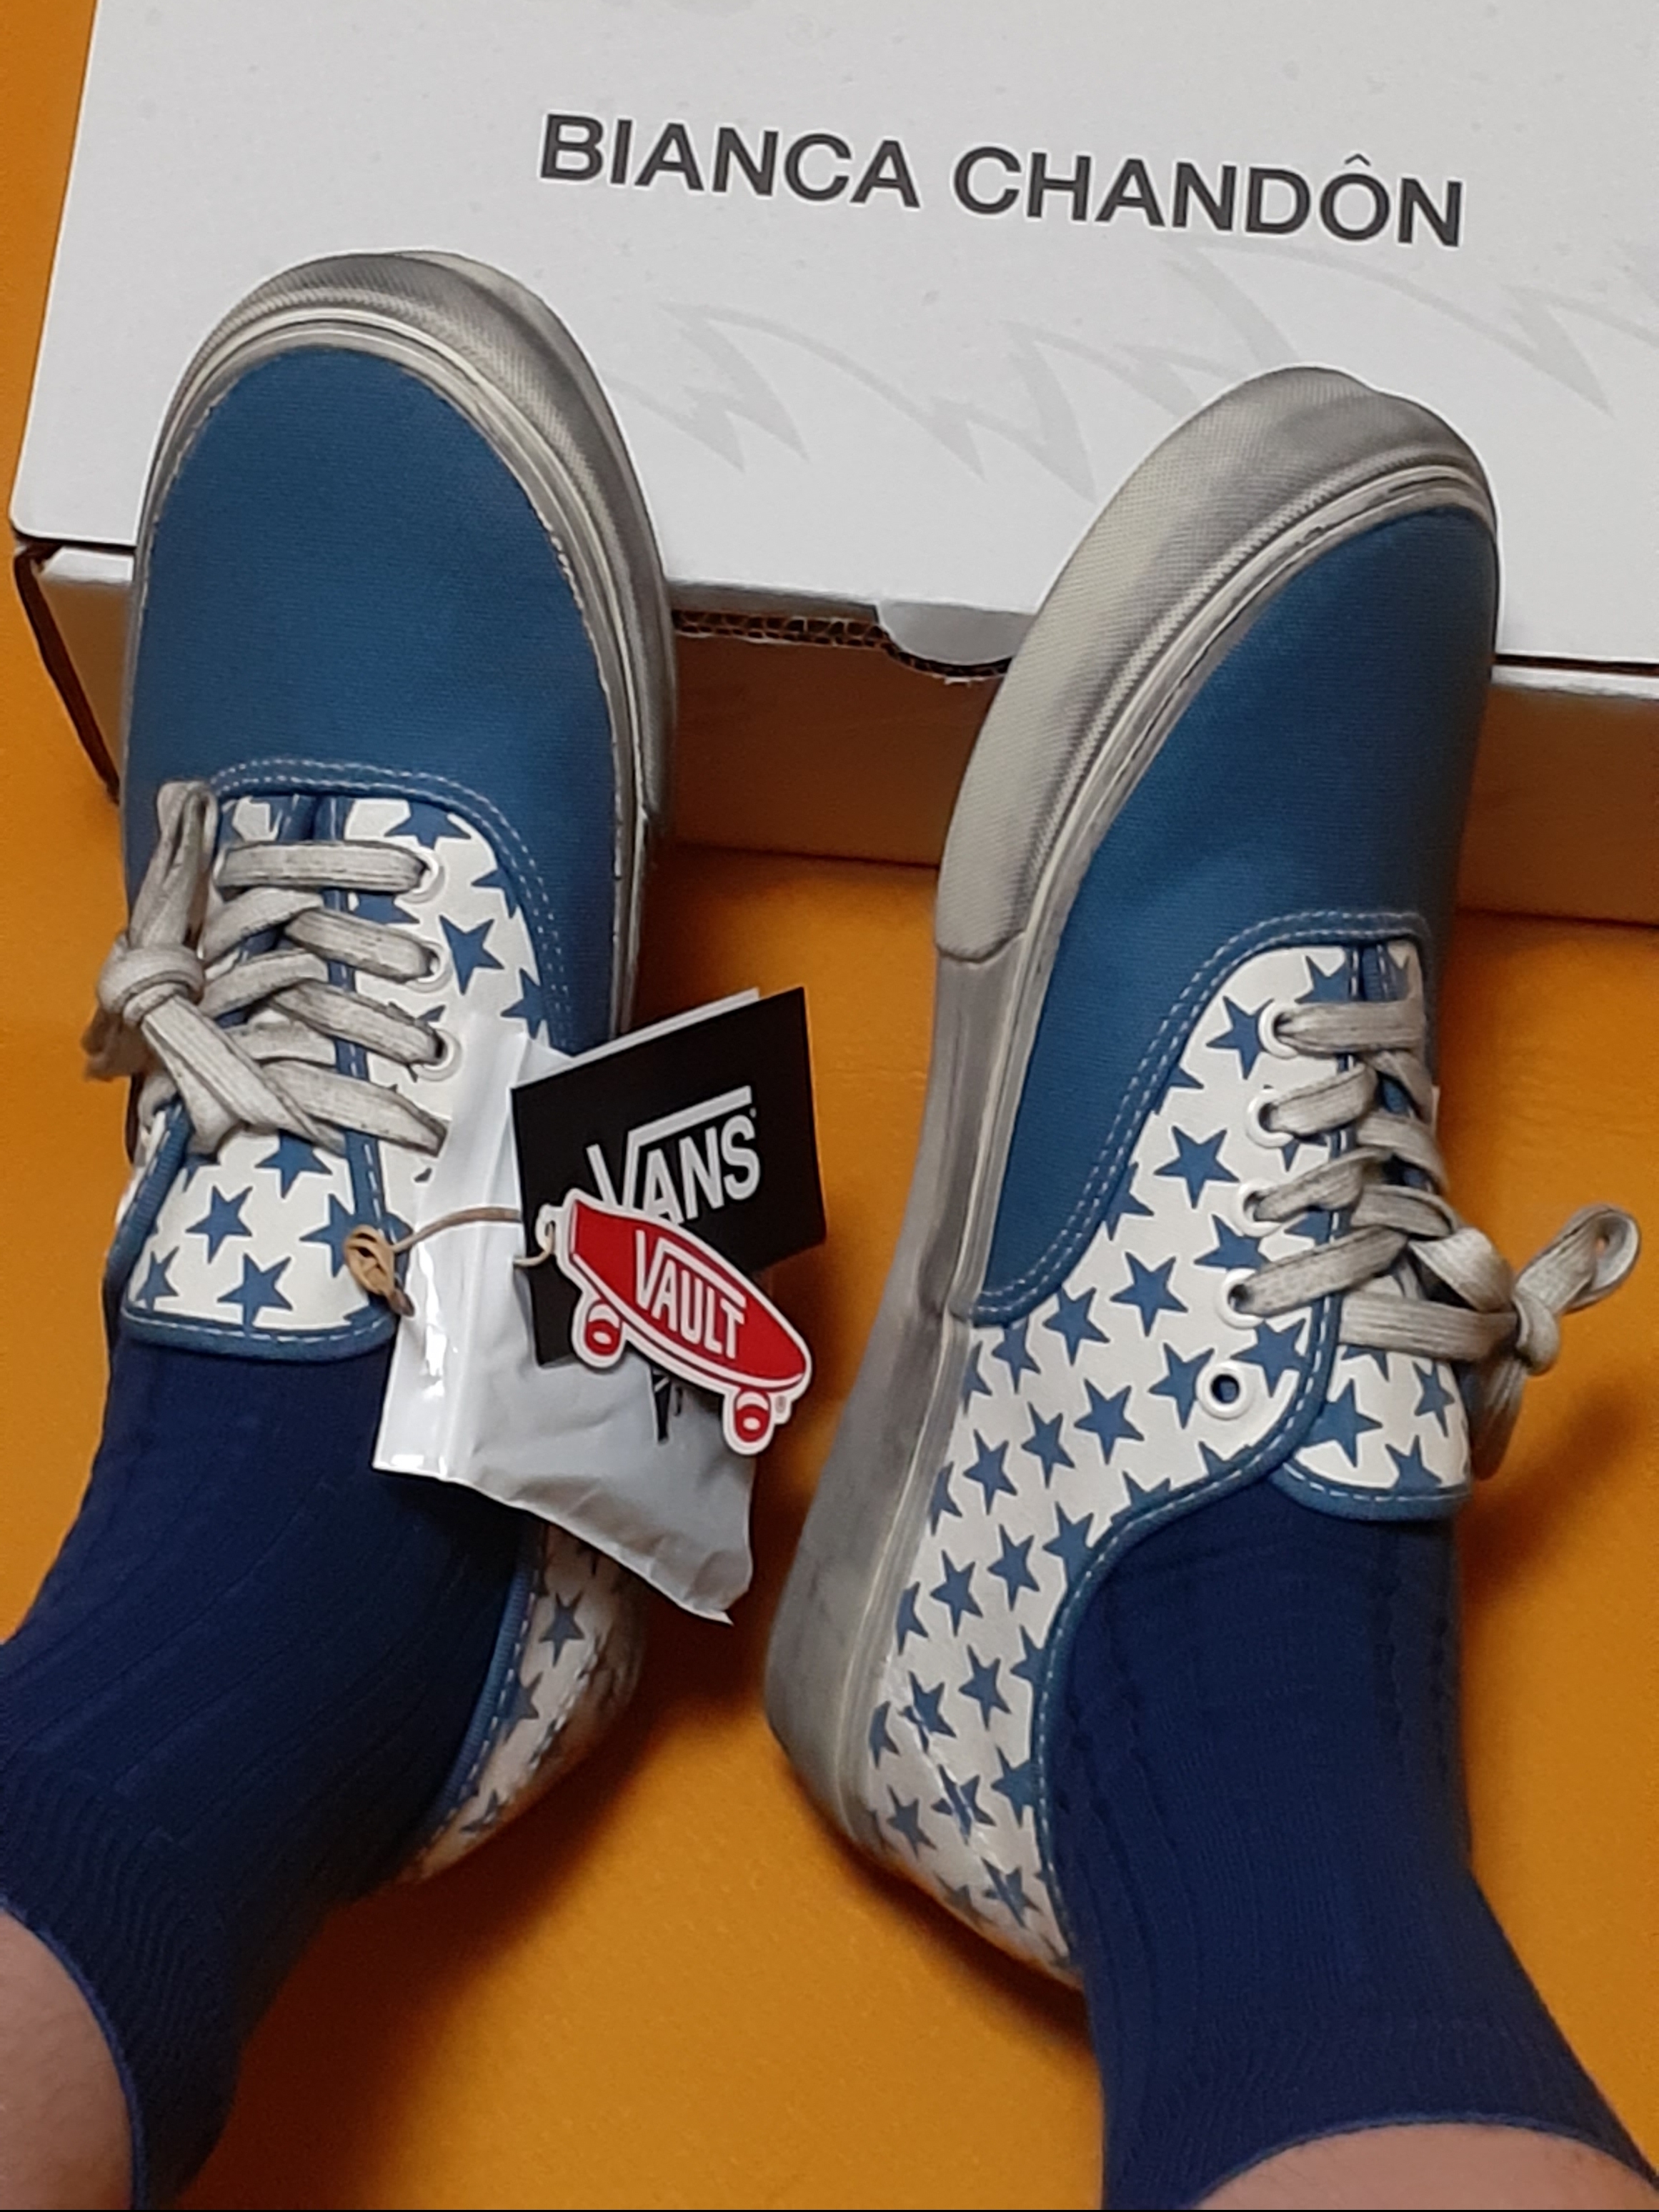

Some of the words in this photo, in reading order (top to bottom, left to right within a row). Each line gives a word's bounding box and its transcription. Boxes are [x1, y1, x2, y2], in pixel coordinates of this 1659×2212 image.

[540, 113, 920, 209] BIANCA
[952, 146, 1463, 248] CHANDÔN
[586, 1085, 760, 1226] VANS
[634, 1229, 747, 1359] VAULT
